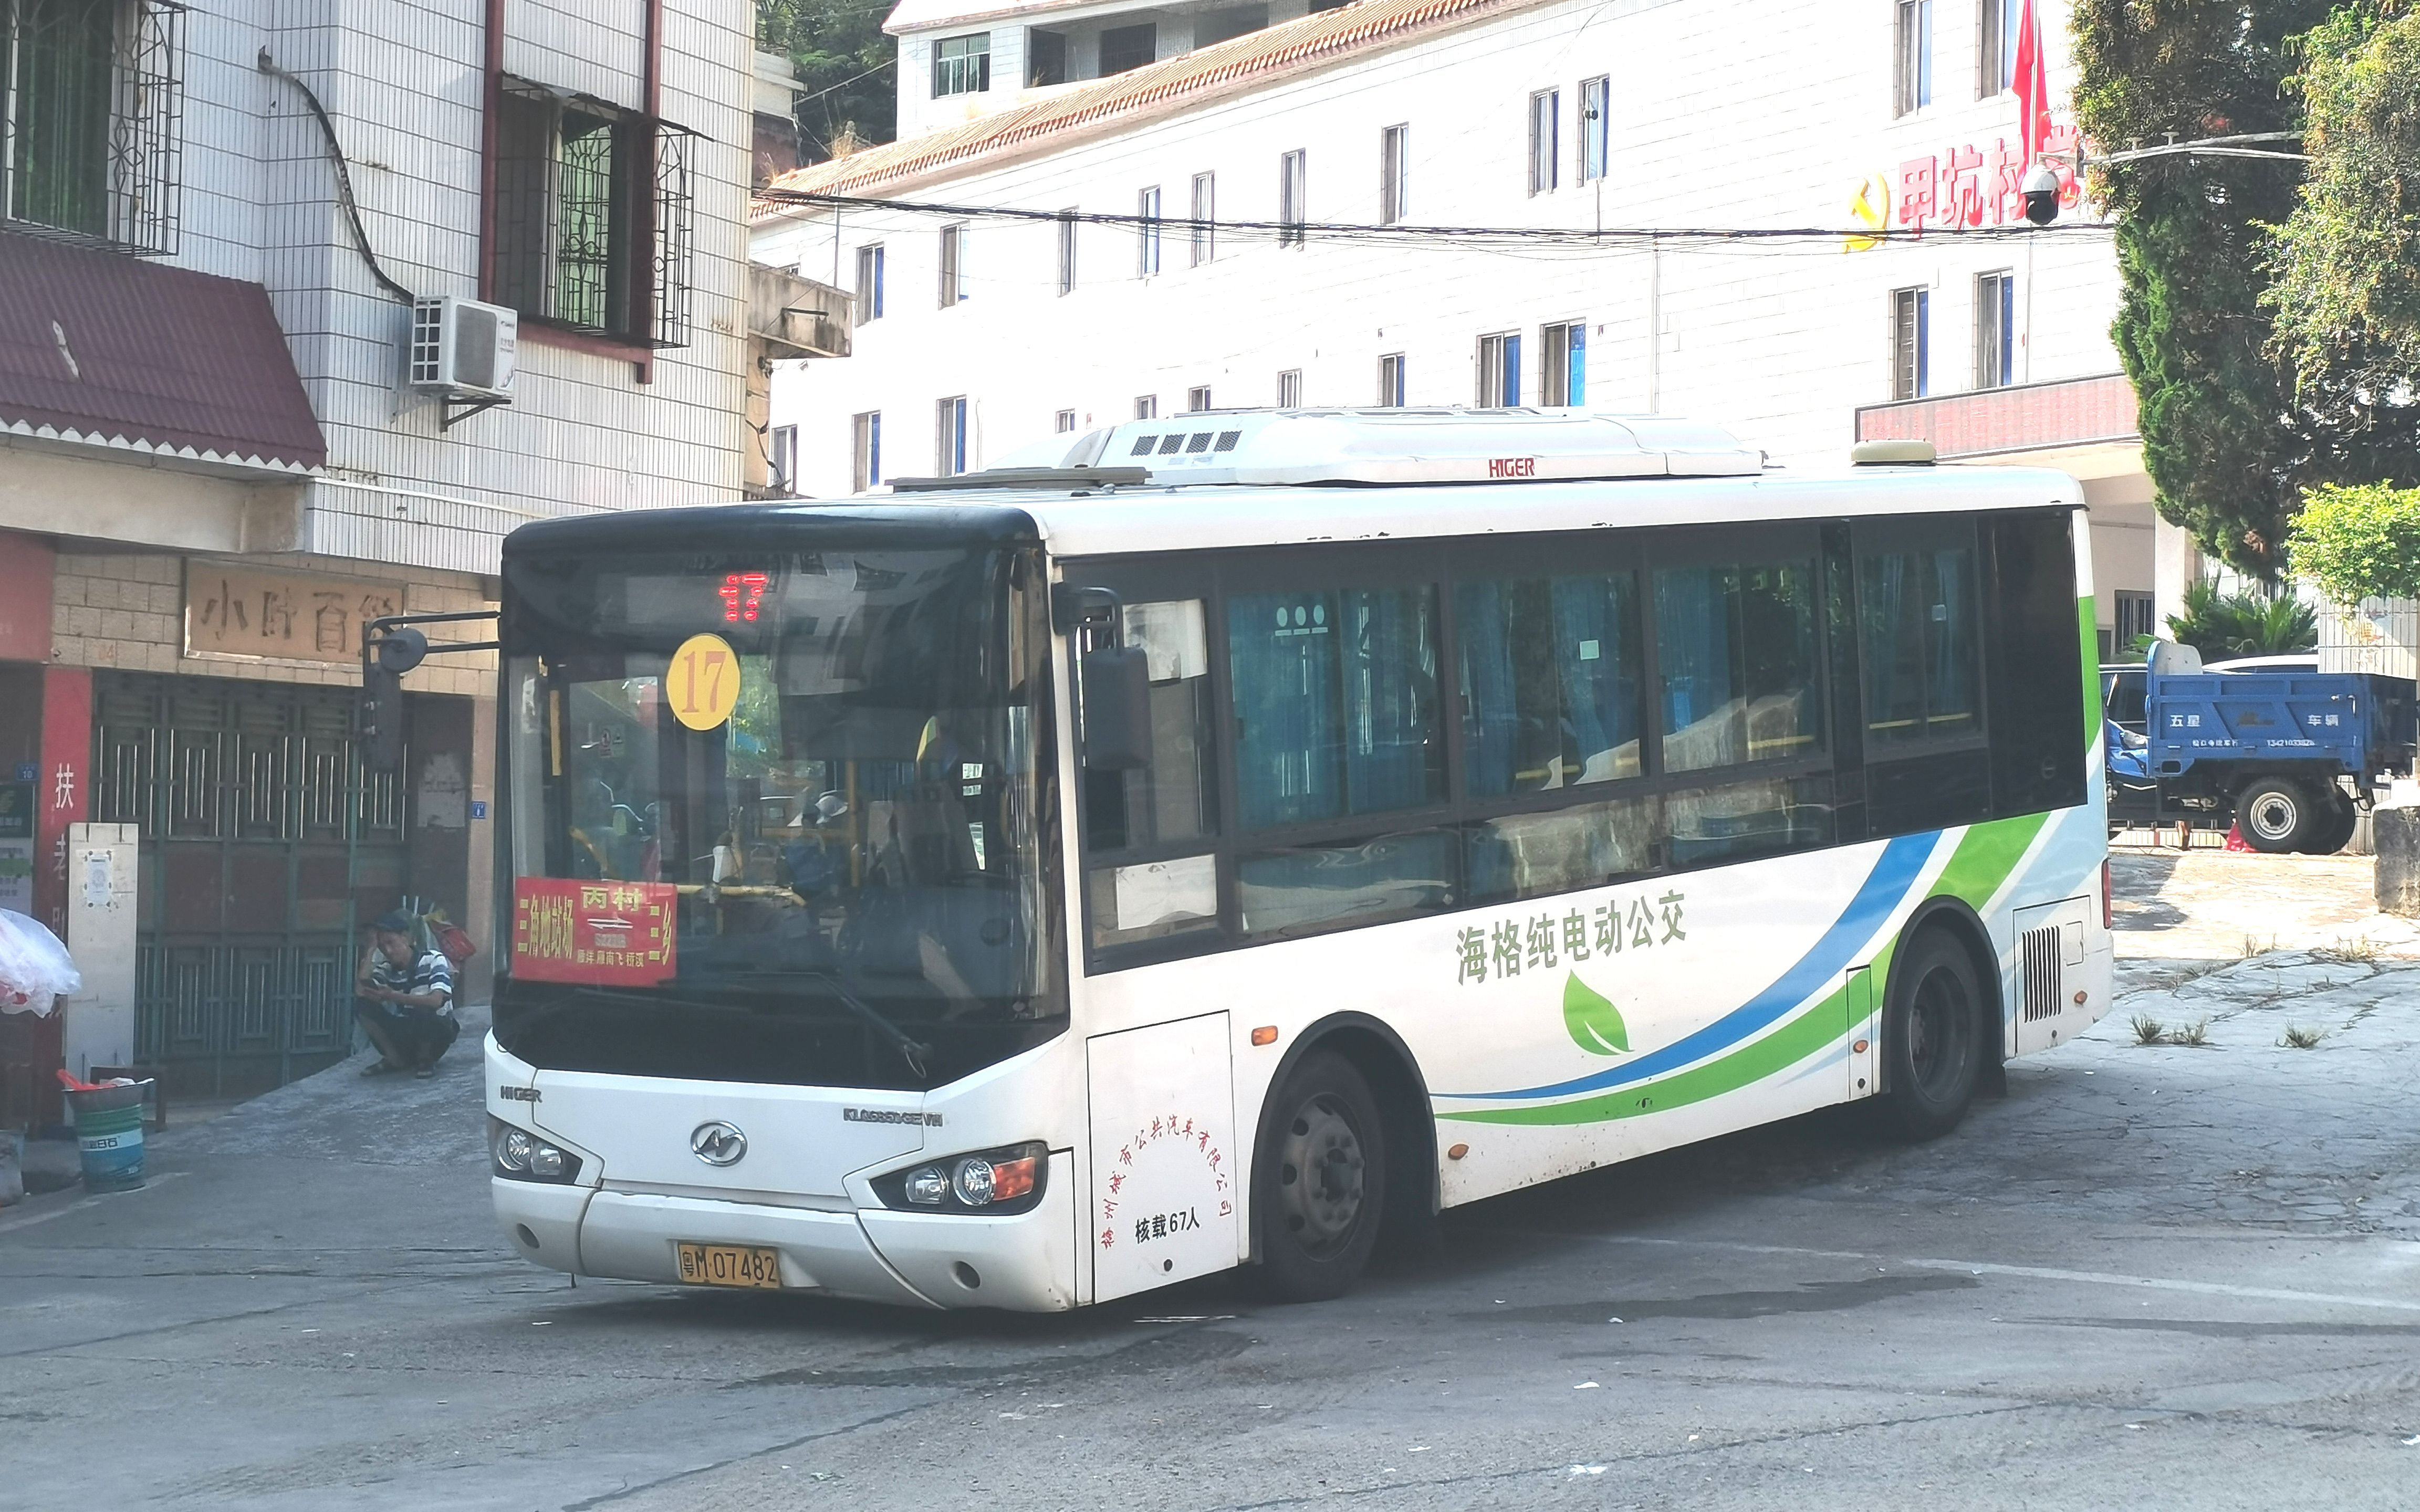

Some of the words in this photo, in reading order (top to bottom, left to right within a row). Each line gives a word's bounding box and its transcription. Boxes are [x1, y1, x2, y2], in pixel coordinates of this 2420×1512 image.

[1488, 455, 1535, 478] HIGER
[718, 573, 768, 622] 17
[681, 650, 727, 713] 17
[2170, 714, 2200, 727] 五星
[580, 886, 643, 911] 丙村
[1456, 889, 1687, 986] 海格纯电动公交
[500, 1085, 543, 1104] HIGER
[1135, 1206, 1200, 1244] 核载67人
